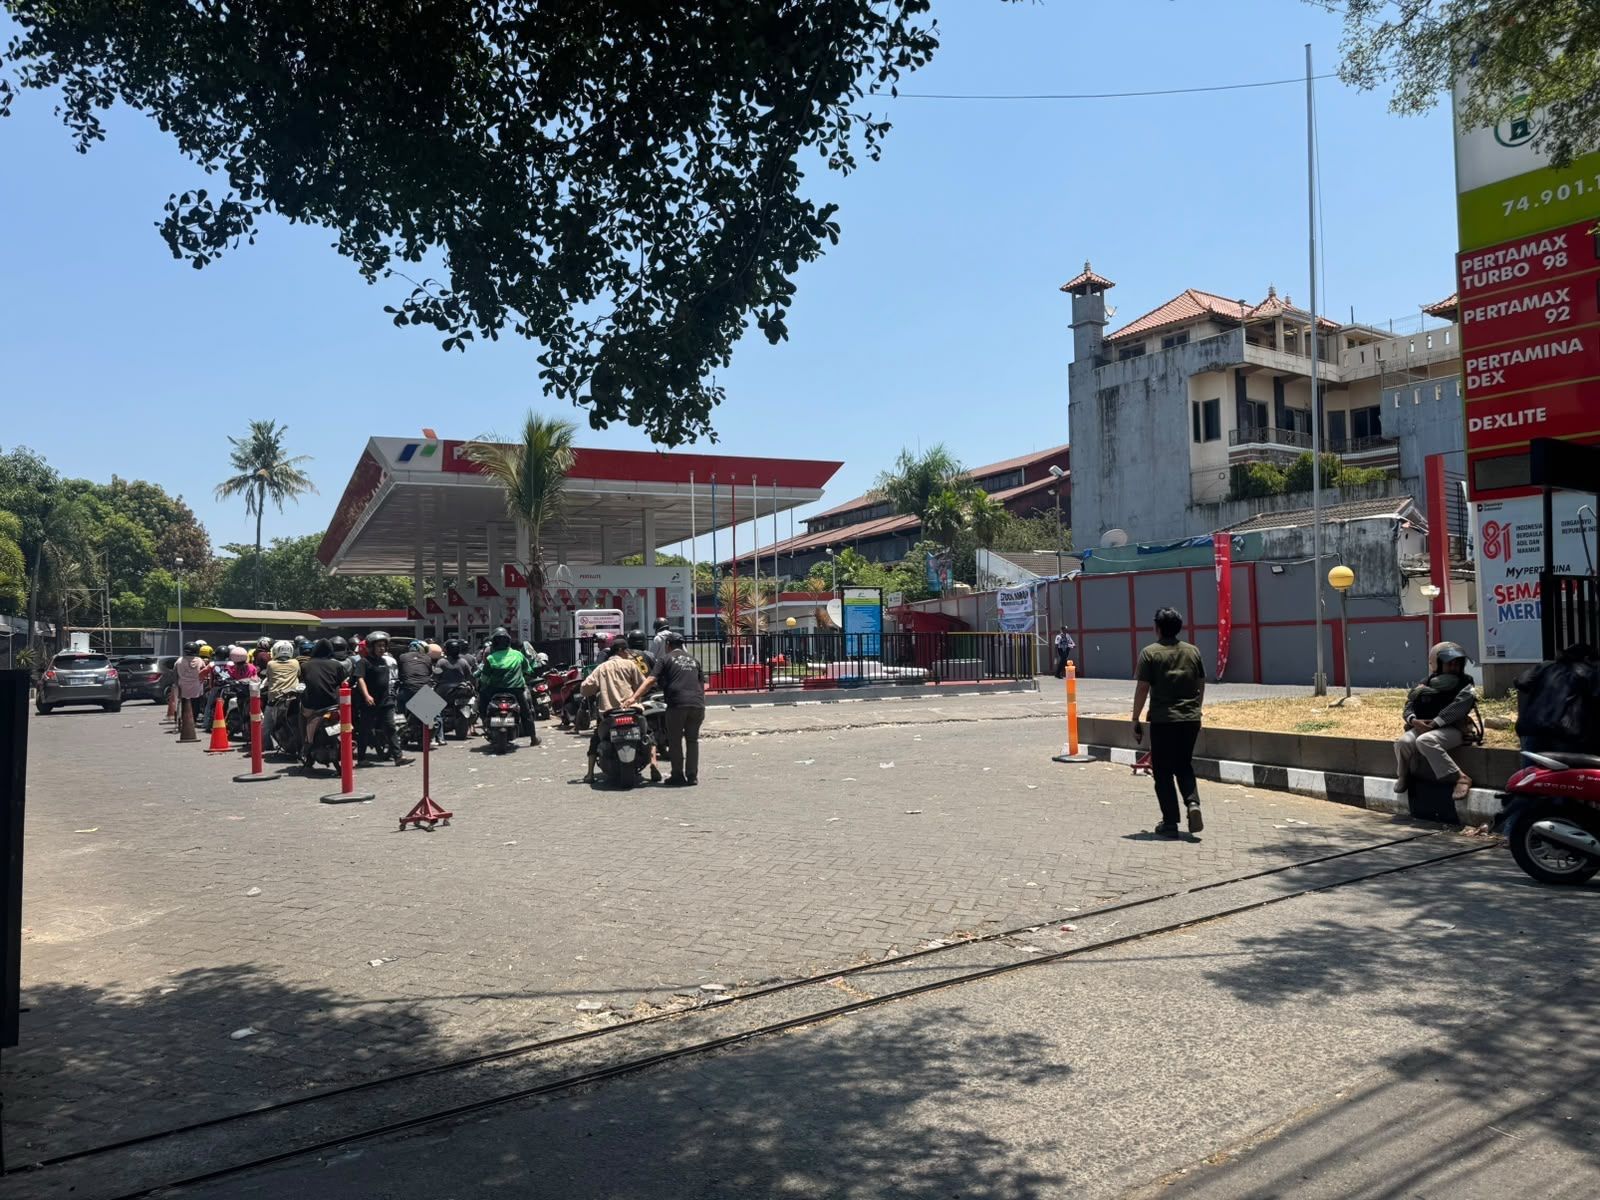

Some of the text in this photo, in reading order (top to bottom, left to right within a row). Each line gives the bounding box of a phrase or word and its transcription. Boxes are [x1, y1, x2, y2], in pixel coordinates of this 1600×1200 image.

[1461, 234, 1568, 274] PERTAMAX
[1463, 252, 1568, 290] TURBO 98
[1463, 287, 1571, 325] PERTAMAX
[1544, 306, 1571, 324] 92
[1466, 337, 1584, 373] PERTAMINA
[1466, 369, 1506, 390] DEX
[1468, 407, 1547, 433] DEXLITE
[1482, 520, 1512, 563] 81
[1516, 530, 1544, 539] BERDAULA
[482, 583, 488, 592] 3
[510, 573, 515, 582] 1
